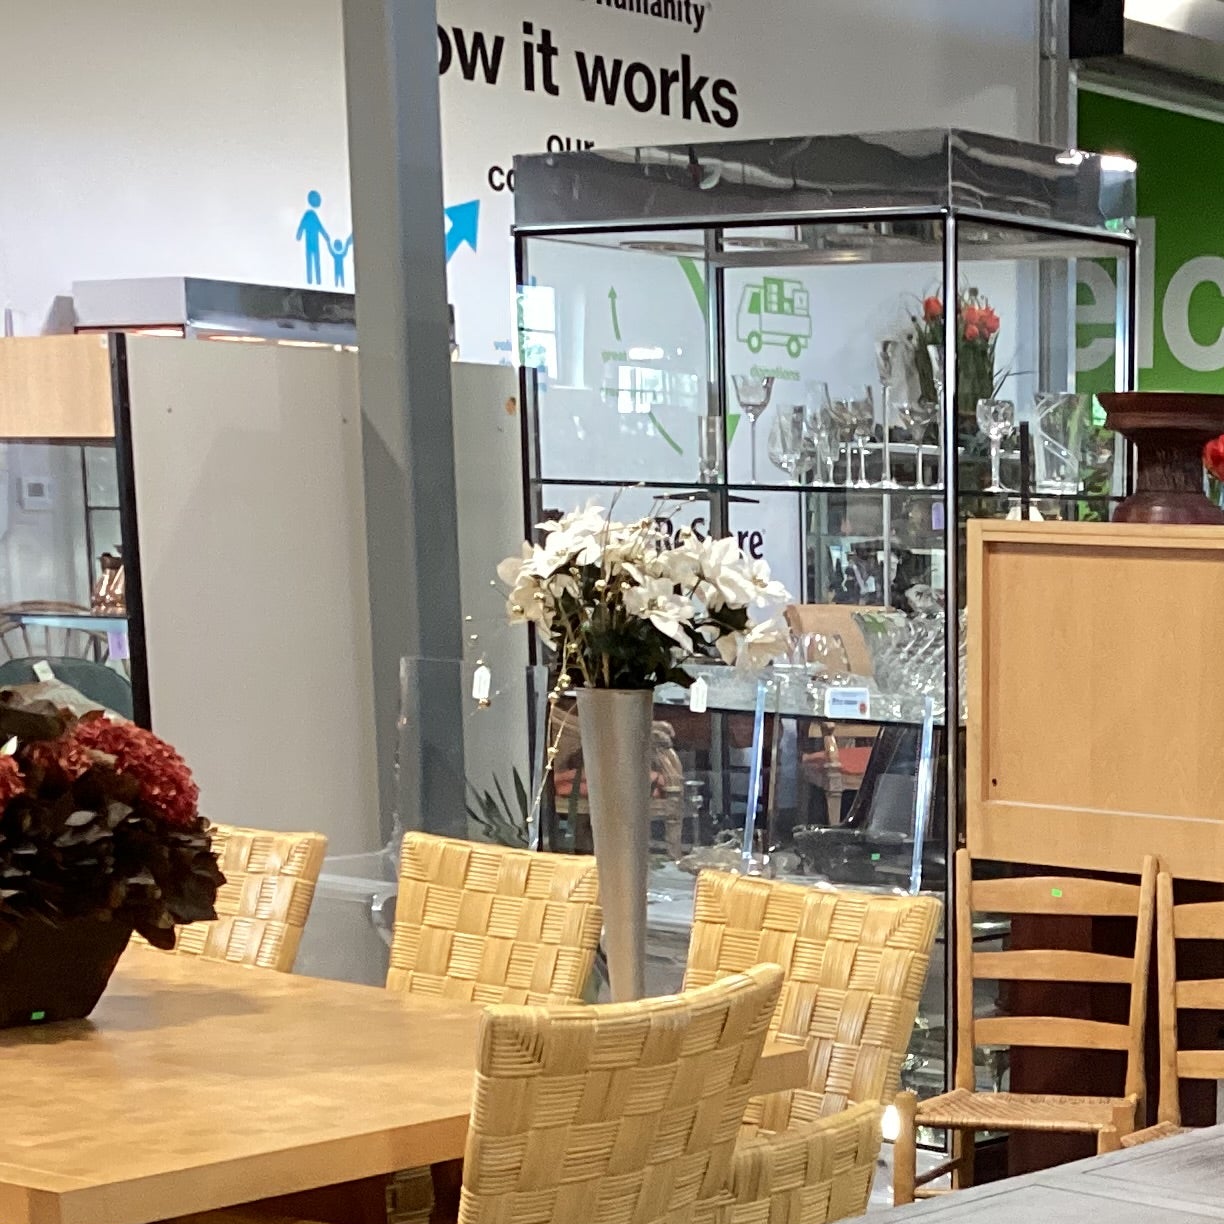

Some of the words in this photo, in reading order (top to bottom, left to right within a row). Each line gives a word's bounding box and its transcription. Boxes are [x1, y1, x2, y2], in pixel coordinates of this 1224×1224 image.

[596, 0, 704, 33] umanity
[522, 21, 559, 96] it
[575, 51, 738, 128] works
